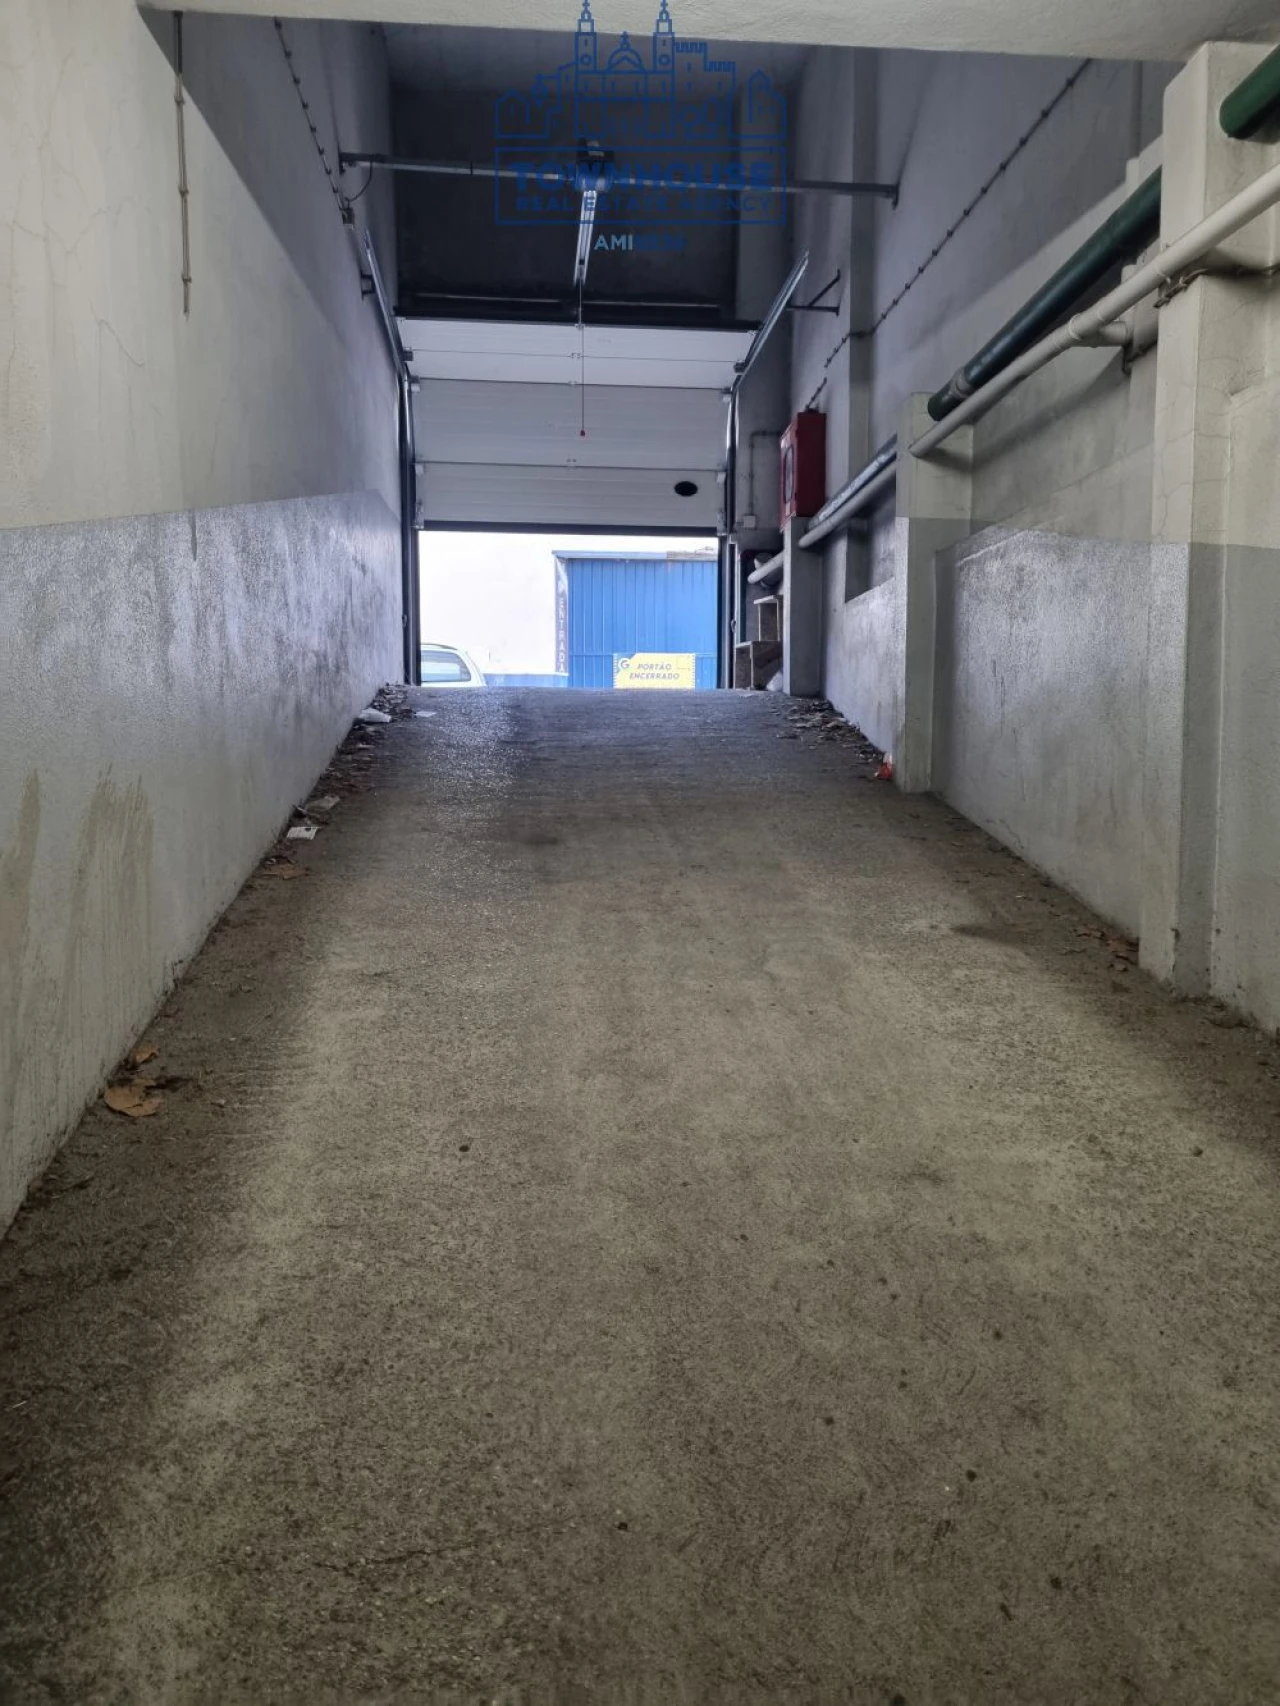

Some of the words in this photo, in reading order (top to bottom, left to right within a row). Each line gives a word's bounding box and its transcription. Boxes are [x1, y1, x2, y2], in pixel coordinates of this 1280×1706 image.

[558, 599, 566, 673] ENTRADA
[638, 662, 672, 671] PORTÃO
[629, 672, 680, 680] ENCERRADO
